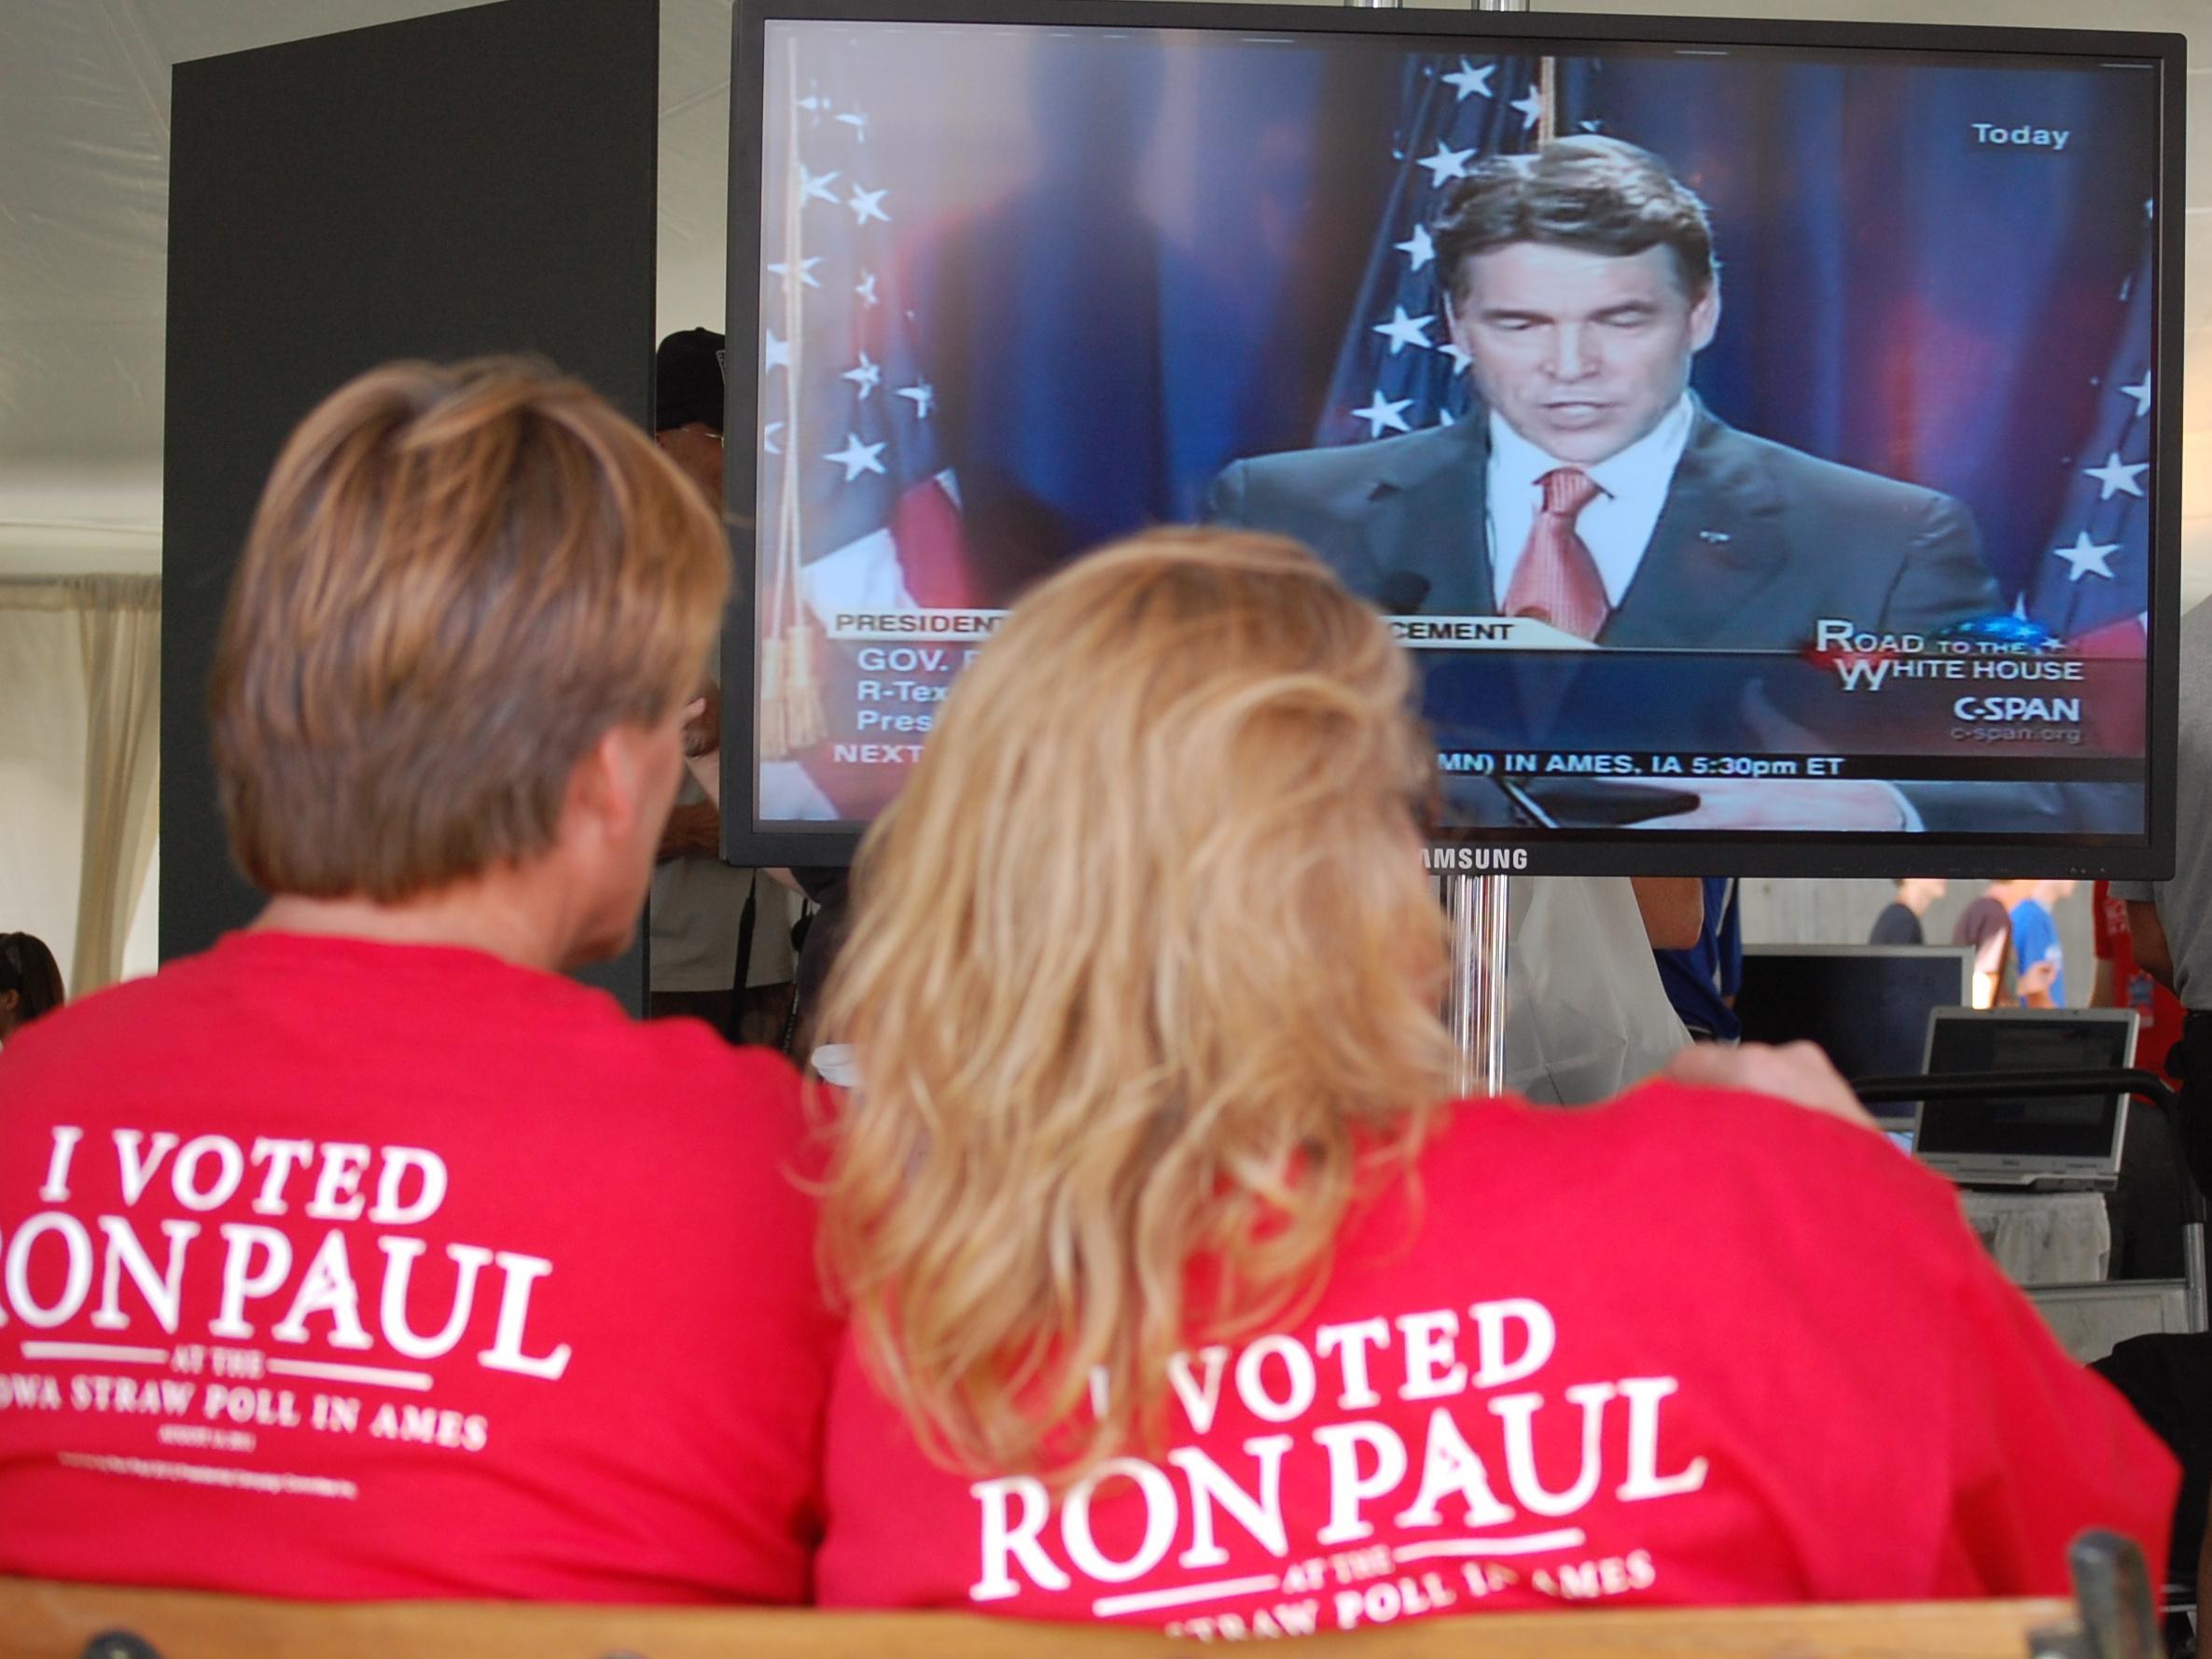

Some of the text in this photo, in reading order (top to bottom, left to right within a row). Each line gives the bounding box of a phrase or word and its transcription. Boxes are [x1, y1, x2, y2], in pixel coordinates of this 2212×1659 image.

[1971, 123, 2070, 150] Today
[856, 647, 950, 672] GOV.
[1816, 619, 2026, 654] ROAD TO THE
[1835, 659, 2084, 691] WHITE HOUSE
[1954, 696, 2080, 721] C-SPAN
[833, 745, 925, 763] NEXT
[1505, 754, 1537, 772] IN
[1652, 756, 1682, 774] IA
[1691, 757, 1797, 777] 5:30pm
[1806, 759, 1845, 775] ET
[39, 1125, 449, 1225] I VOTED
[0, 1211, 572, 1381] ON PAUL
[1165, 1297, 1556, 1435] VOTED
[71, 1374, 195, 1416] STRAW
[203, 1383, 300, 1428] POLL
[312, 1394, 361, 1432] IN
[369, 1403, 488, 1452] AMES
[969, 1376, 1708, 1601] RON PAUL
[1334, 1571, 1456, 1630] POLL
